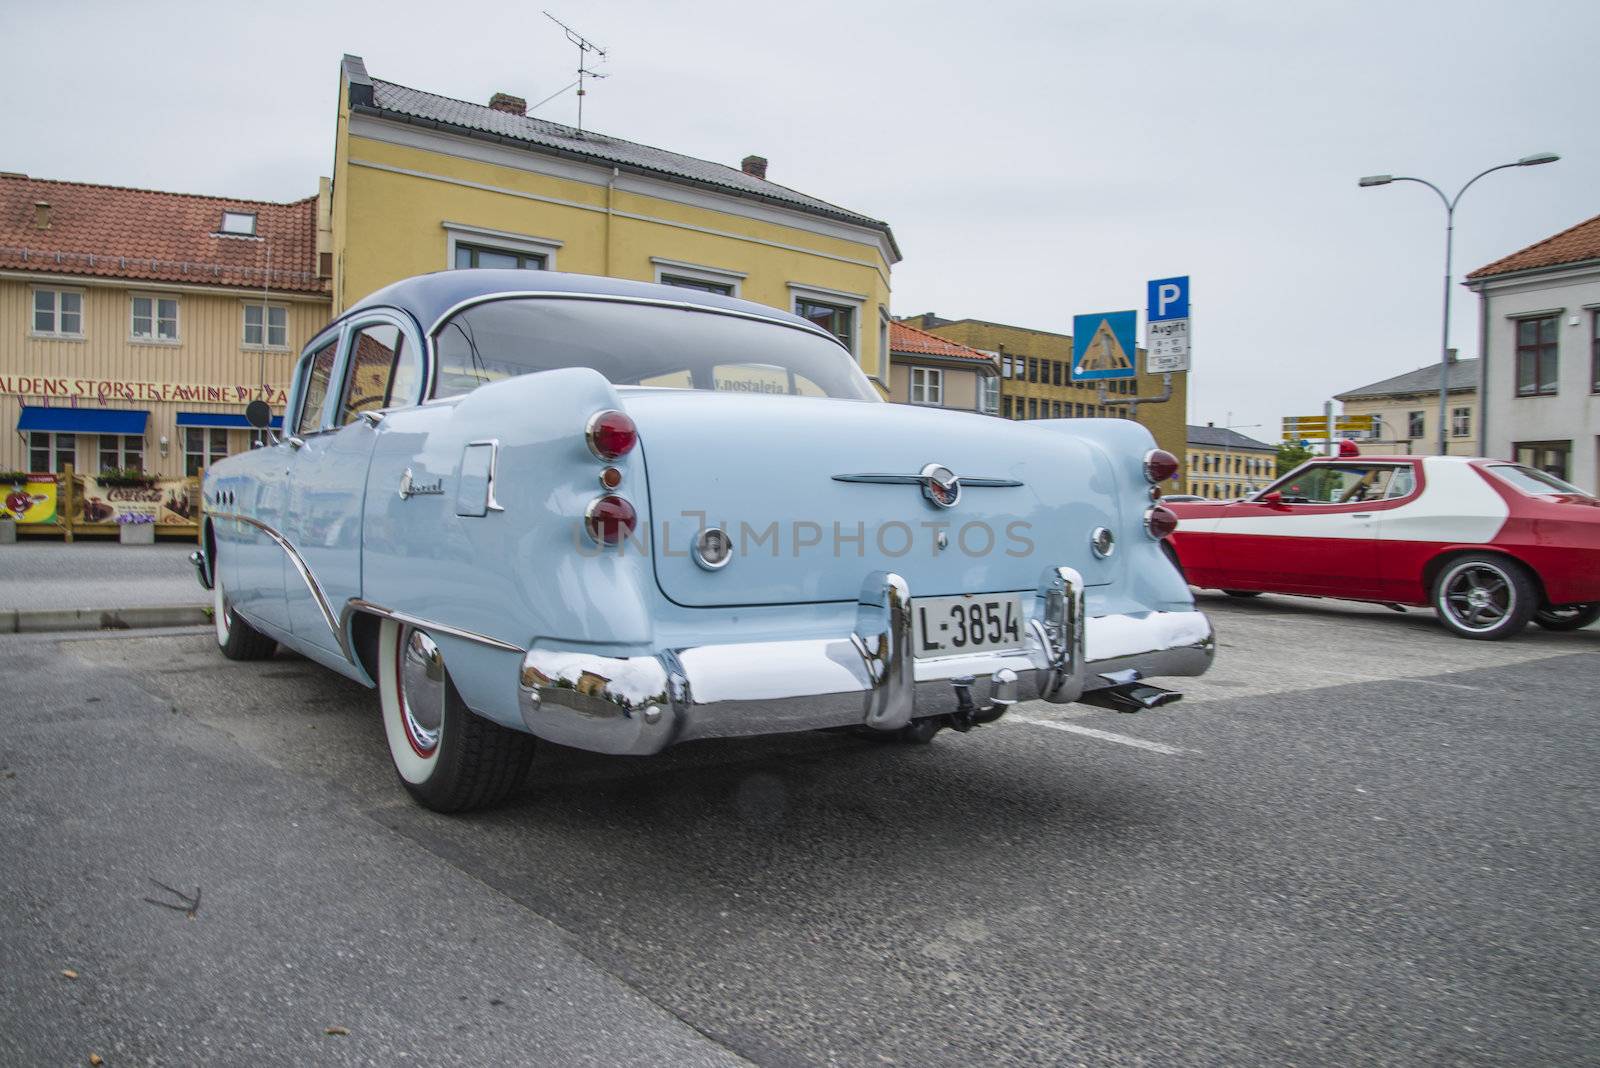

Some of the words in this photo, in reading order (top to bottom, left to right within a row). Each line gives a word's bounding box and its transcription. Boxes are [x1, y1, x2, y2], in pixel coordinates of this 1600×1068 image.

[1157, 283, 1181, 317] P
[1151, 321, 1187, 337] Avgift
[75, 379, 157, 400] STØRSTE
